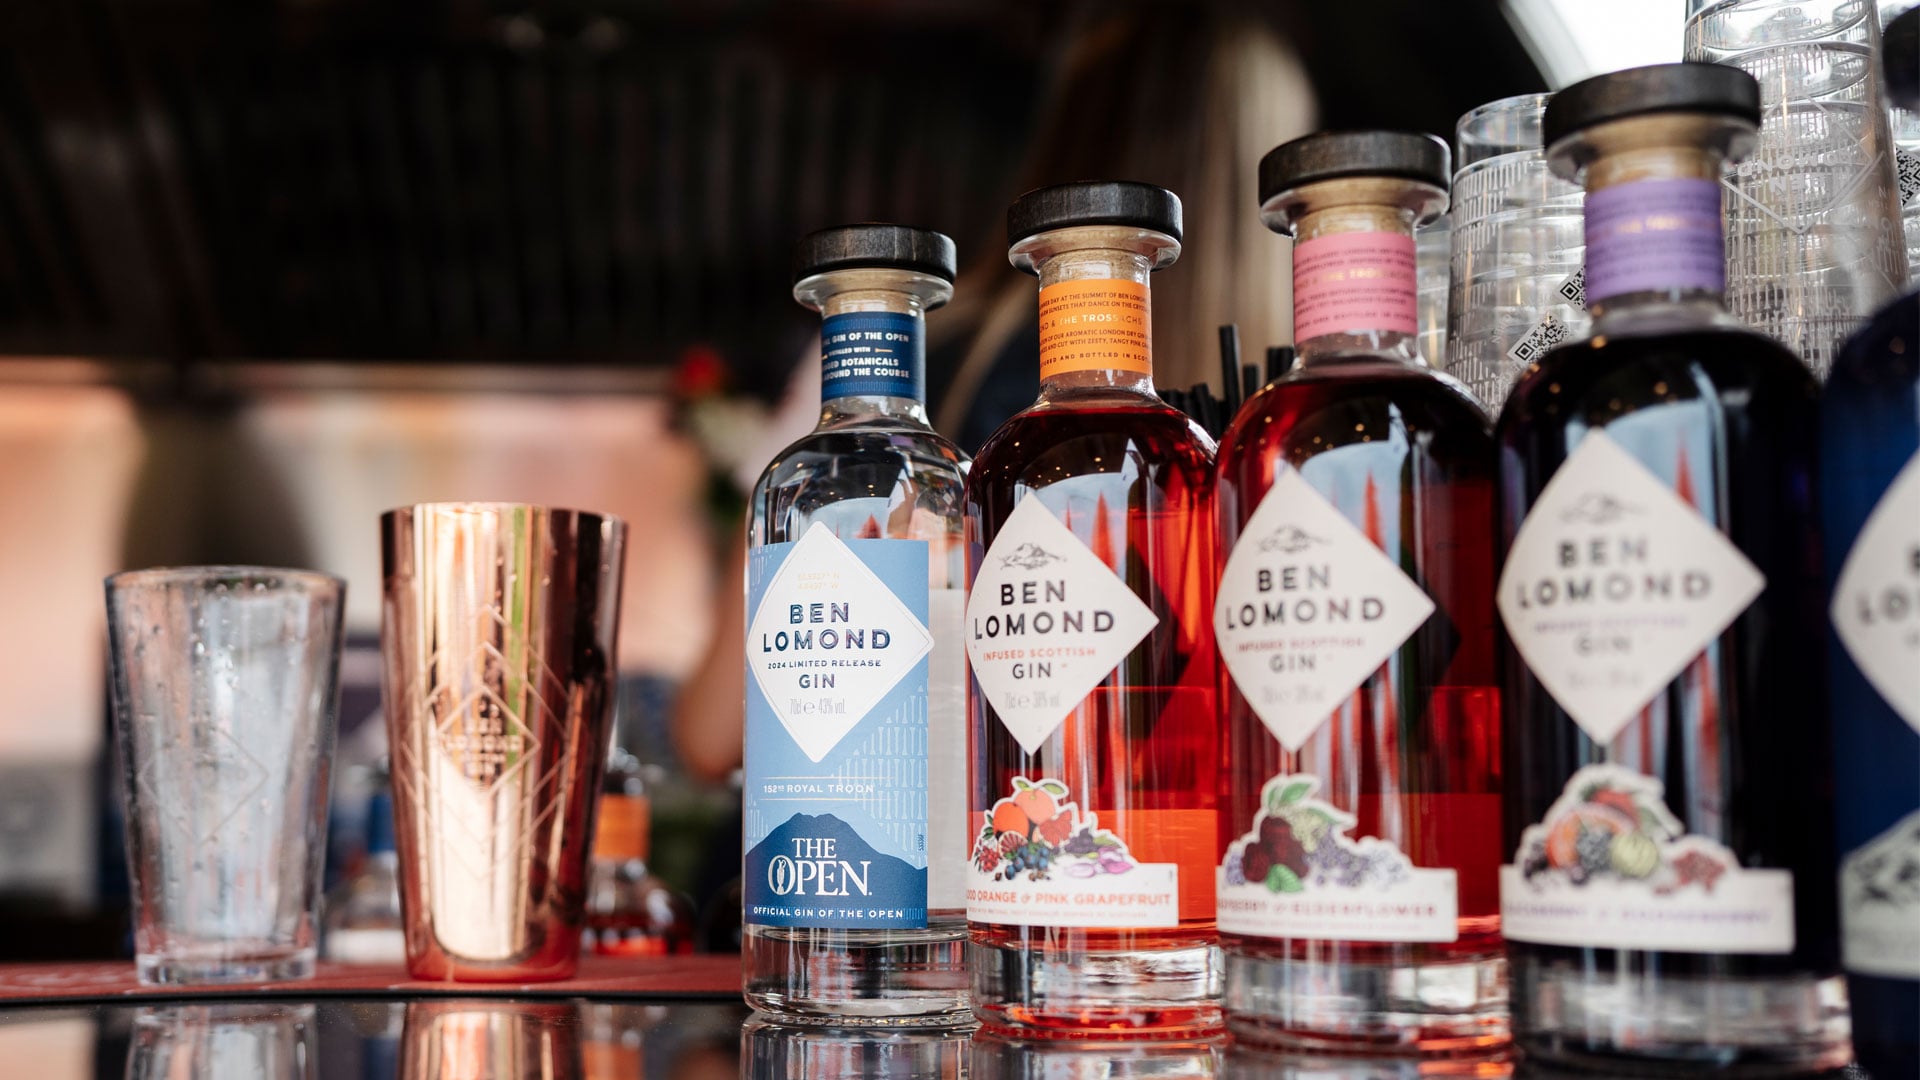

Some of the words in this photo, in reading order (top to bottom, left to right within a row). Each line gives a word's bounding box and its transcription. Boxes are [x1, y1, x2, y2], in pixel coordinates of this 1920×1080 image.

[832, 334, 846, 343] GIN
[848, 332, 862, 341] OF
[864, 332, 882, 340] THE
[885, 332, 909, 343] OPEN
[1066, 329, 1098, 337] AROMATIC
[841, 358, 899, 367] BOTANICALS
[853, 368, 871, 376] THE
[874, 368, 910, 378] COURSE
[1557, 537, 1648, 569] BEN
[1257, 564, 1330, 593] BEN
[1000, 580, 1065, 606] BEN
[1515, 570, 1712, 610] LOMOND
[789, 602, 850, 624] BEN
[1225, 596, 1385, 631] LOMOND
[974, 610, 1115, 640] LOMOND
[763, 628, 891, 653] LOMOND
[983, 650, 1025, 661] INFUSED
[1029, 647, 1097, 659] SCOTTISH
[767, 661, 787, 670] 2024
[789, 659, 828, 668] LIMITED
[831, 659, 882, 668] RELEASE
[1011, 662, 1052, 679] GIN
[1268, 653, 1316, 674] GIN
[798, 673, 836, 689] GIN
[786, 784, 823, 793] ROYAL
[827, 784, 875, 793] TROON
[791, 838, 838, 859] THE
[978, 889, 1018, 904] ORANGE
[1036, 893, 1069, 905] PINK
[1073, 893, 1172, 906] GRAPEFRUIT
[753, 906, 791, 917] OFFICIAL
[794, 908, 814, 917] GIN
[819, 909, 834, 917] OF
[839, 909, 864, 918] THE
[868, 909, 904, 918] OPEN
